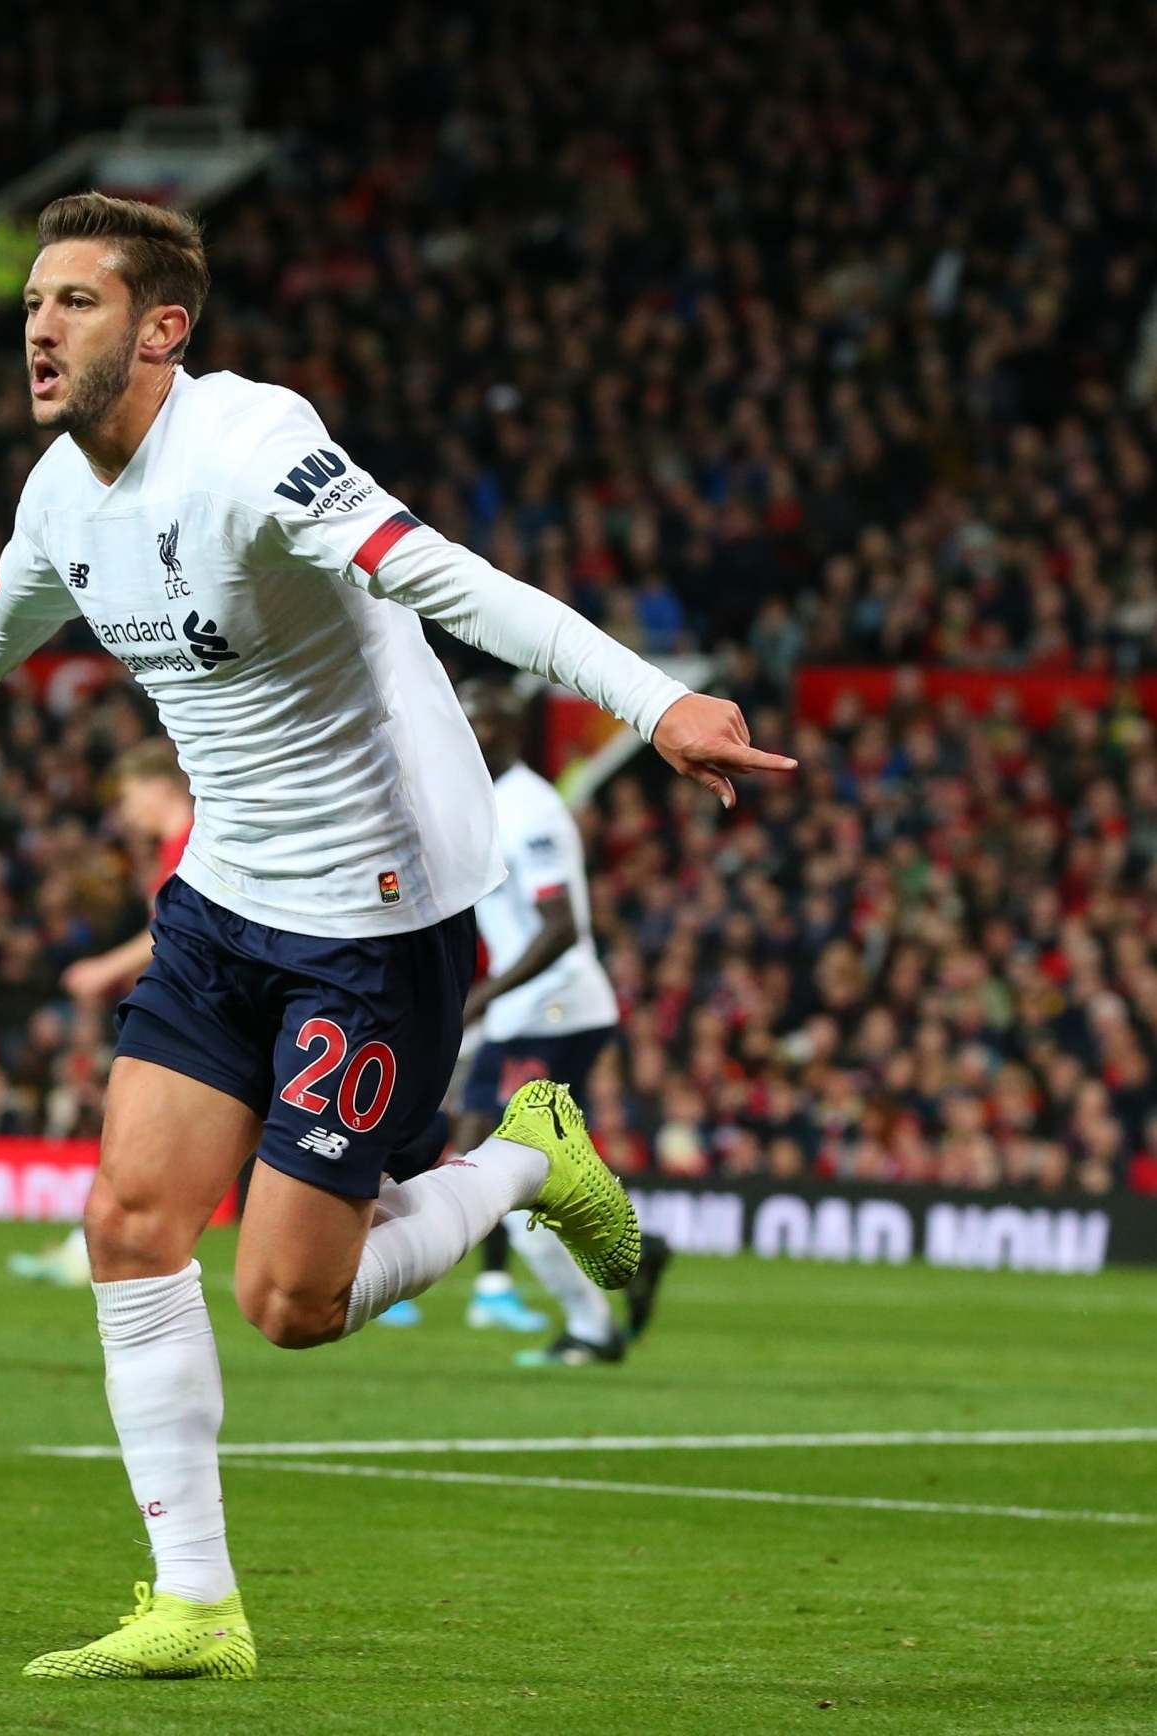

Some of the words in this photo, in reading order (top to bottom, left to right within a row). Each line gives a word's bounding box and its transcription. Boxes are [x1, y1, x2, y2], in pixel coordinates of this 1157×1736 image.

[274, 448, 346, 507] WU
[336, 485, 375, 513] Unio
[121, 648, 195, 672] artered
[280, 1018, 396, 1132] 20
